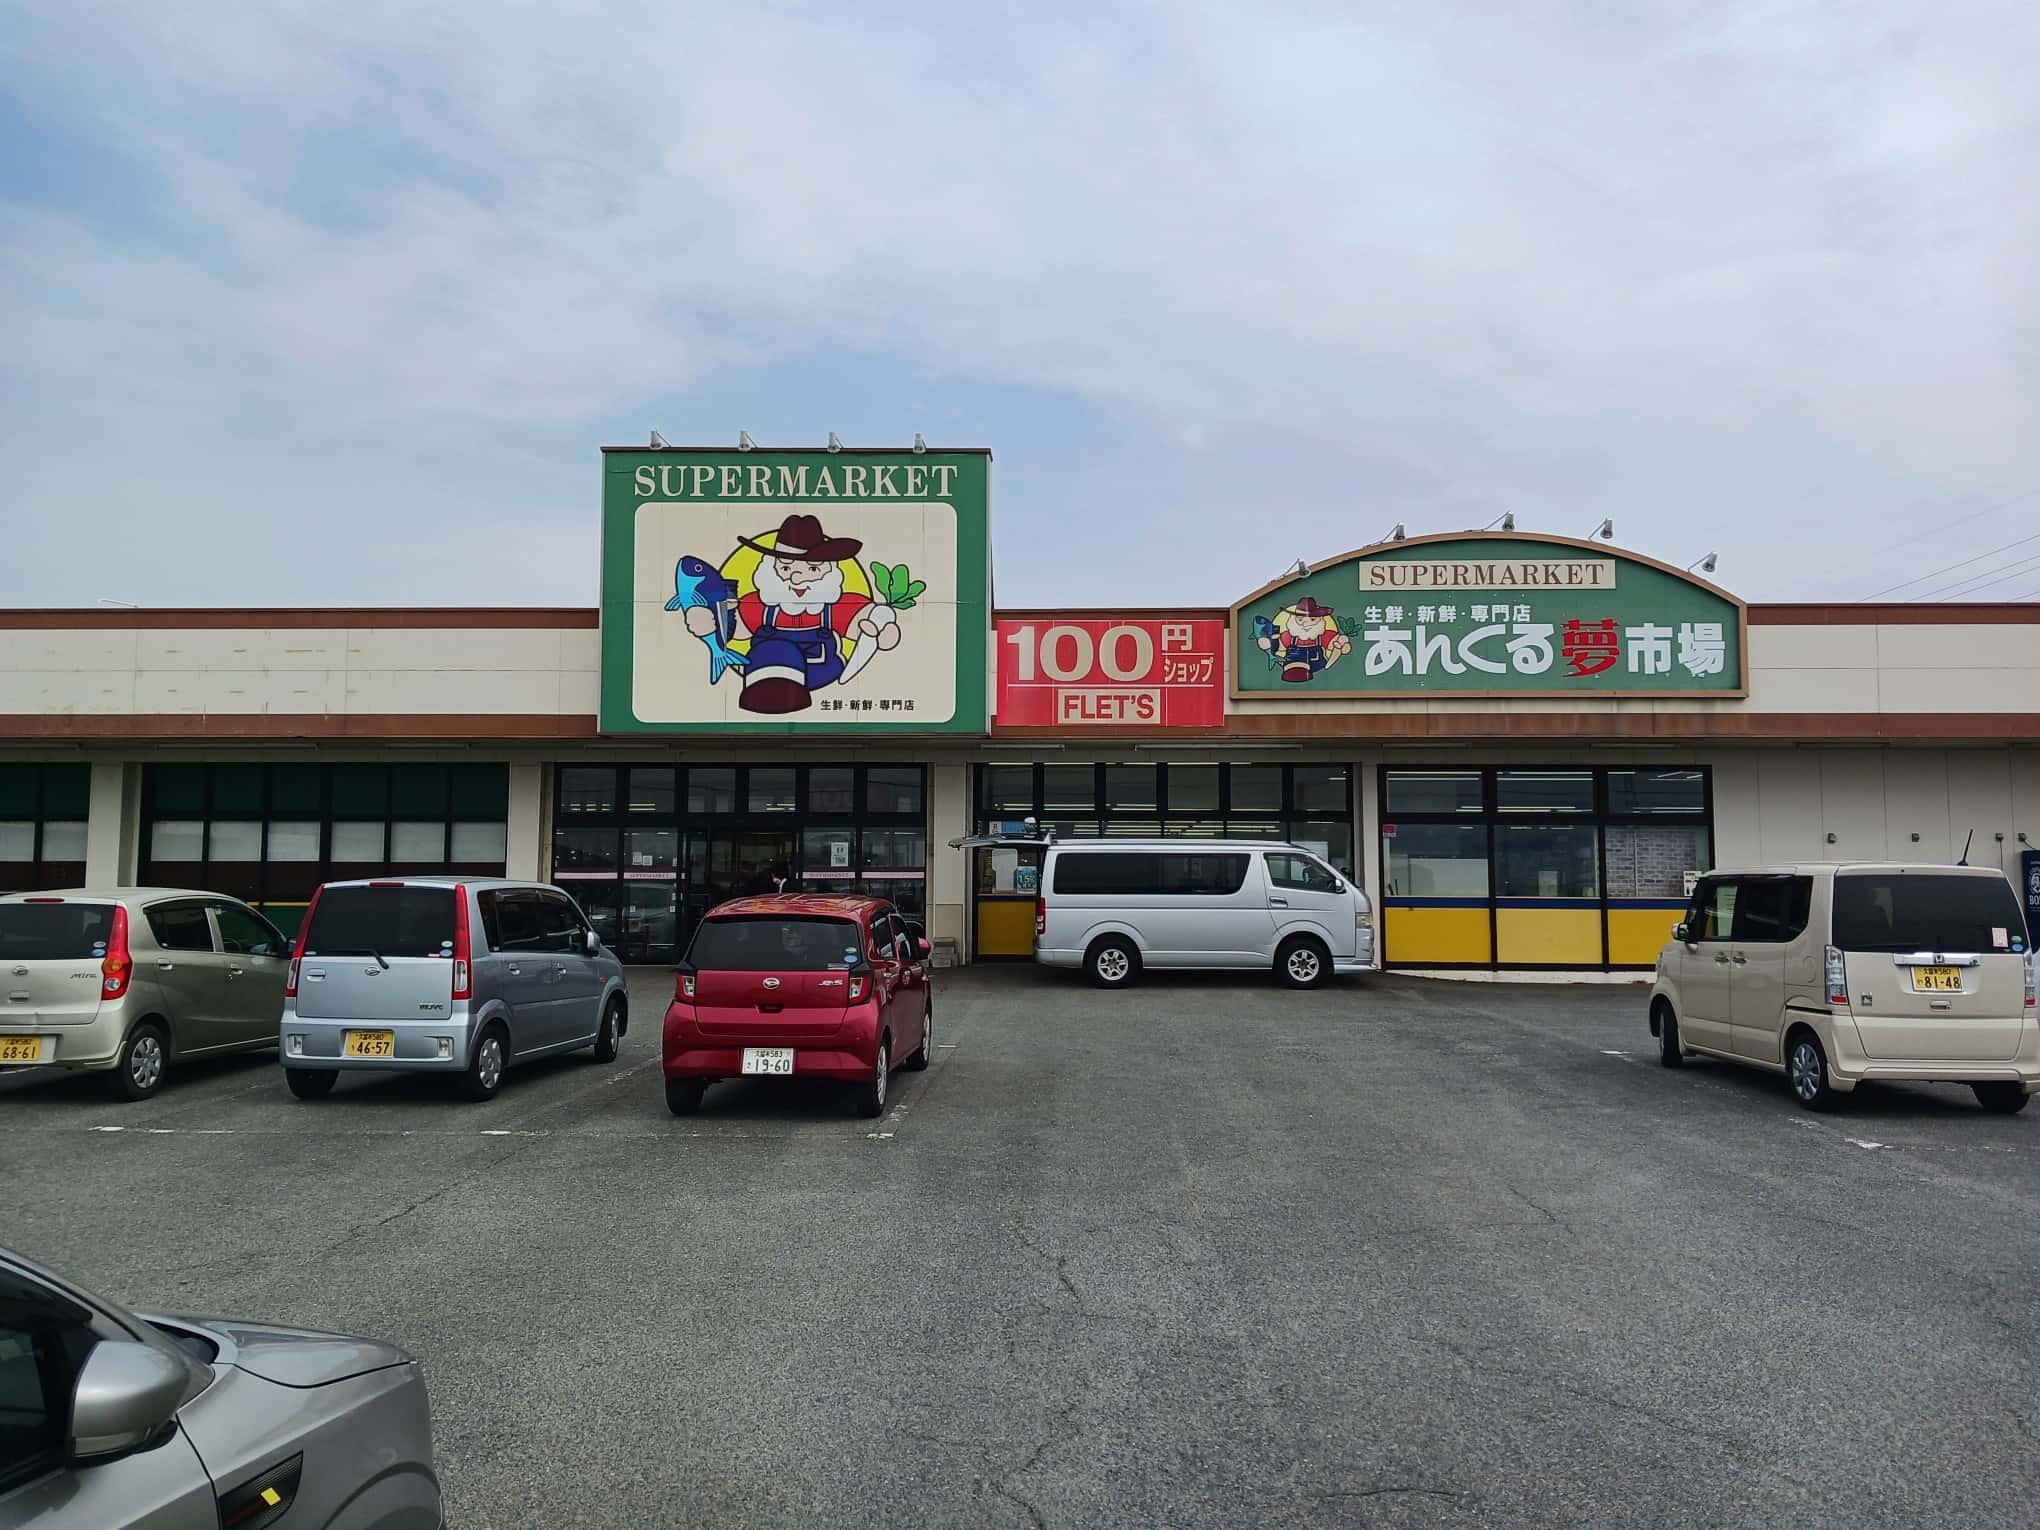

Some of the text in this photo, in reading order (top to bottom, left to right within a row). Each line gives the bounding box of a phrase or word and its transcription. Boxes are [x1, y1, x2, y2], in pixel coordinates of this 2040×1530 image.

[634, 465, 958, 497] SUPERMARKET
[1370, 563, 1604, 586] SUPERMARKET
[1162, 624, 1193, 651] 円
[1007, 625, 1154, 682] 100
[1163, 656, 1214, 683] ショップ
[1064, 694, 1155, 719] FLET'S
[3, 1046, 36, 1059] 68-61
[755, 1058, 790, 1072] 19-60
